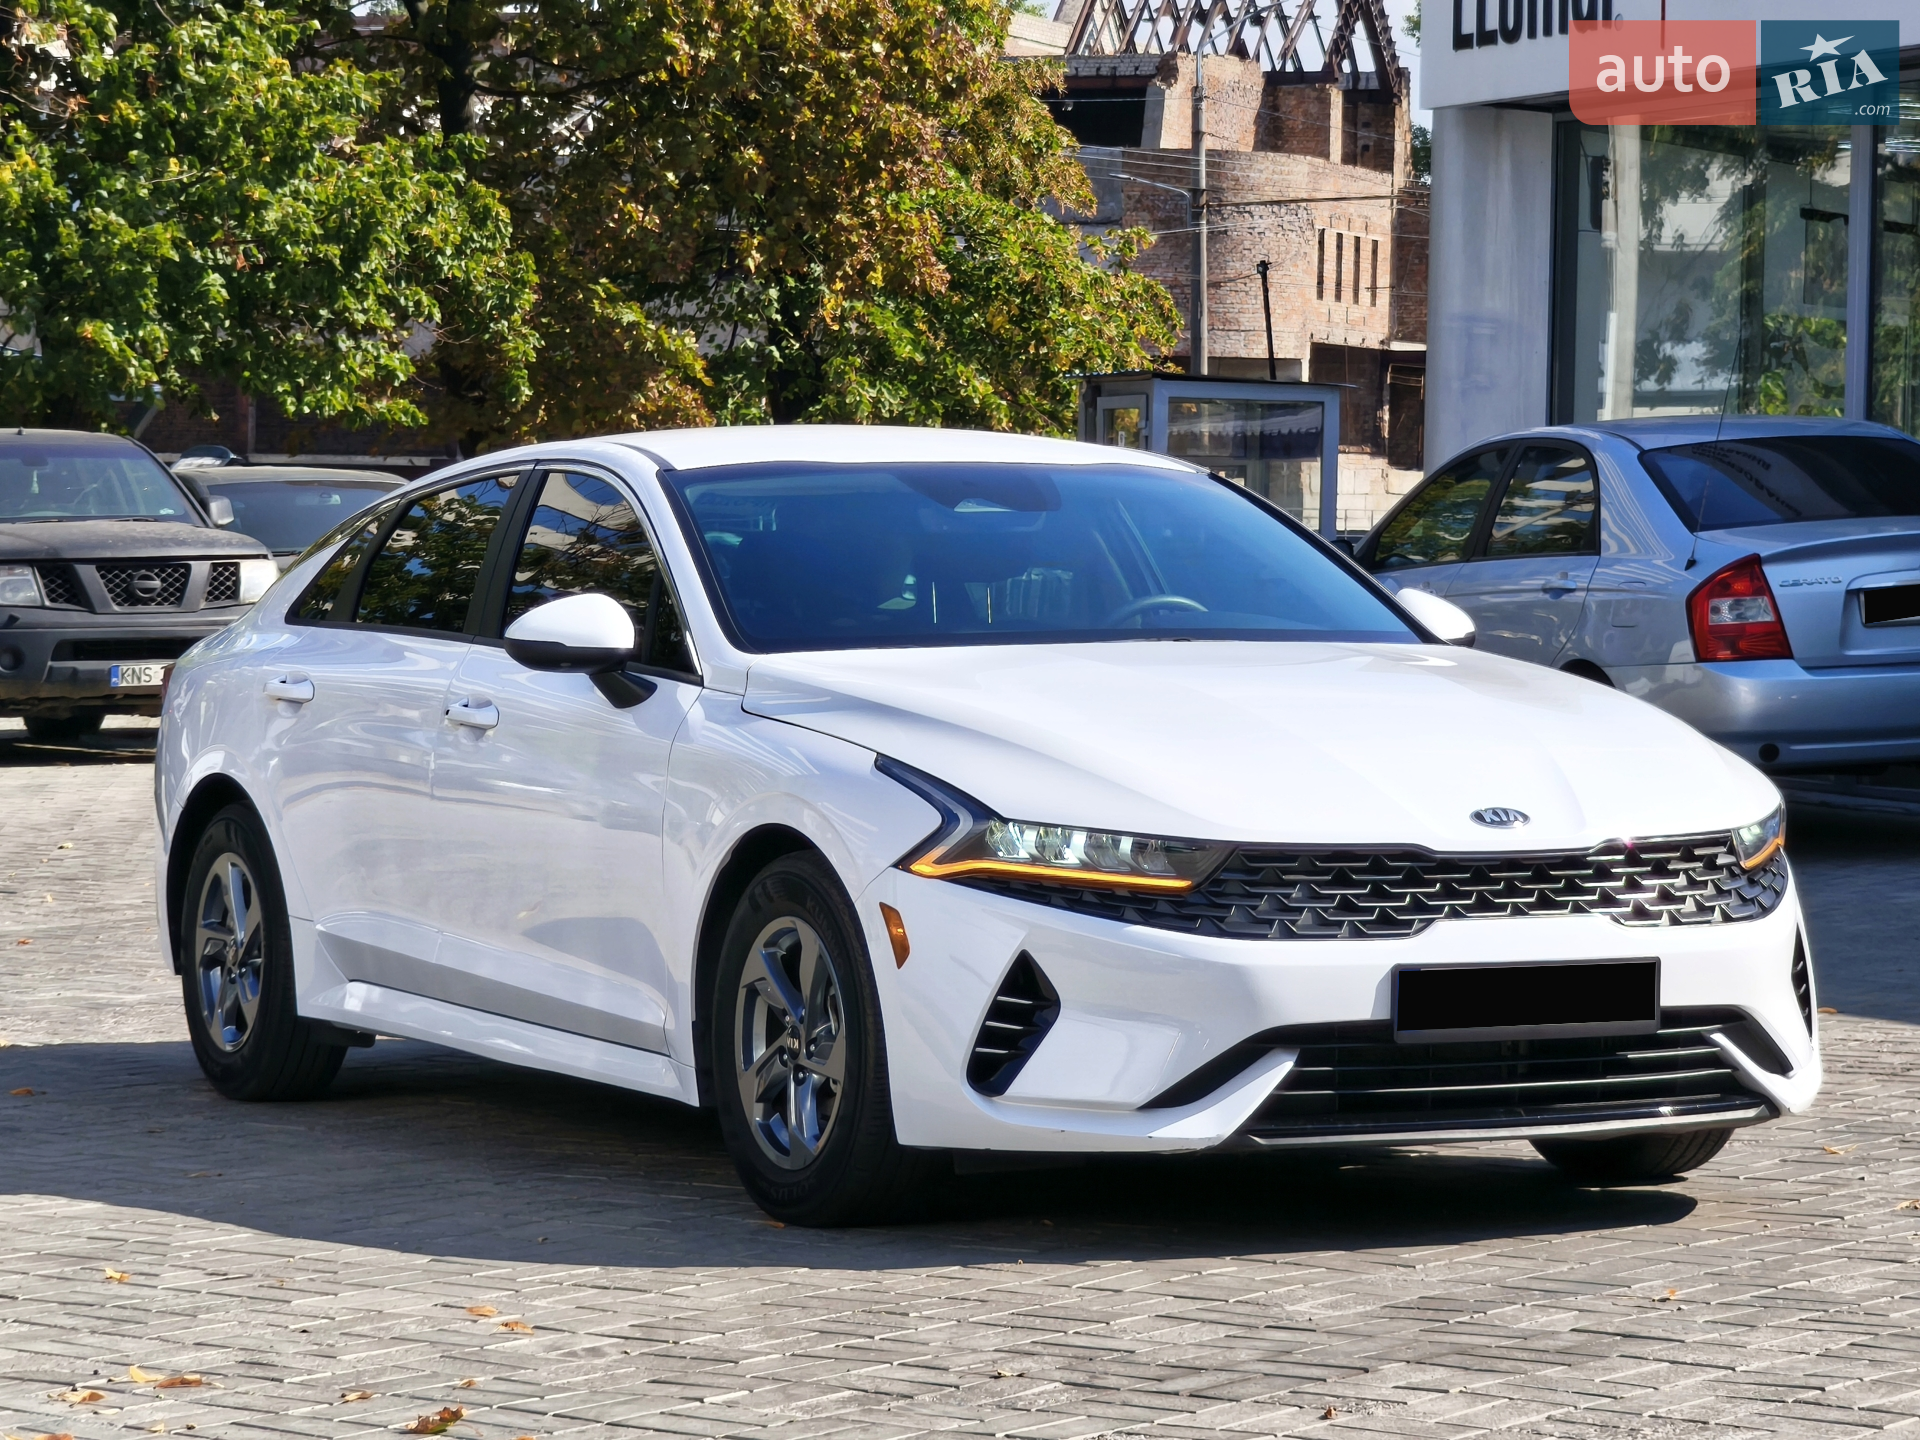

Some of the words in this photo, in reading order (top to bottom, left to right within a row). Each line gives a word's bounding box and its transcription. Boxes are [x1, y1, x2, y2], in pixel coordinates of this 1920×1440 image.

[1779, 576, 1842, 587] CERATO
[1478, 808, 1524, 823] KIA
[786, 1037, 799, 1049] KIA
